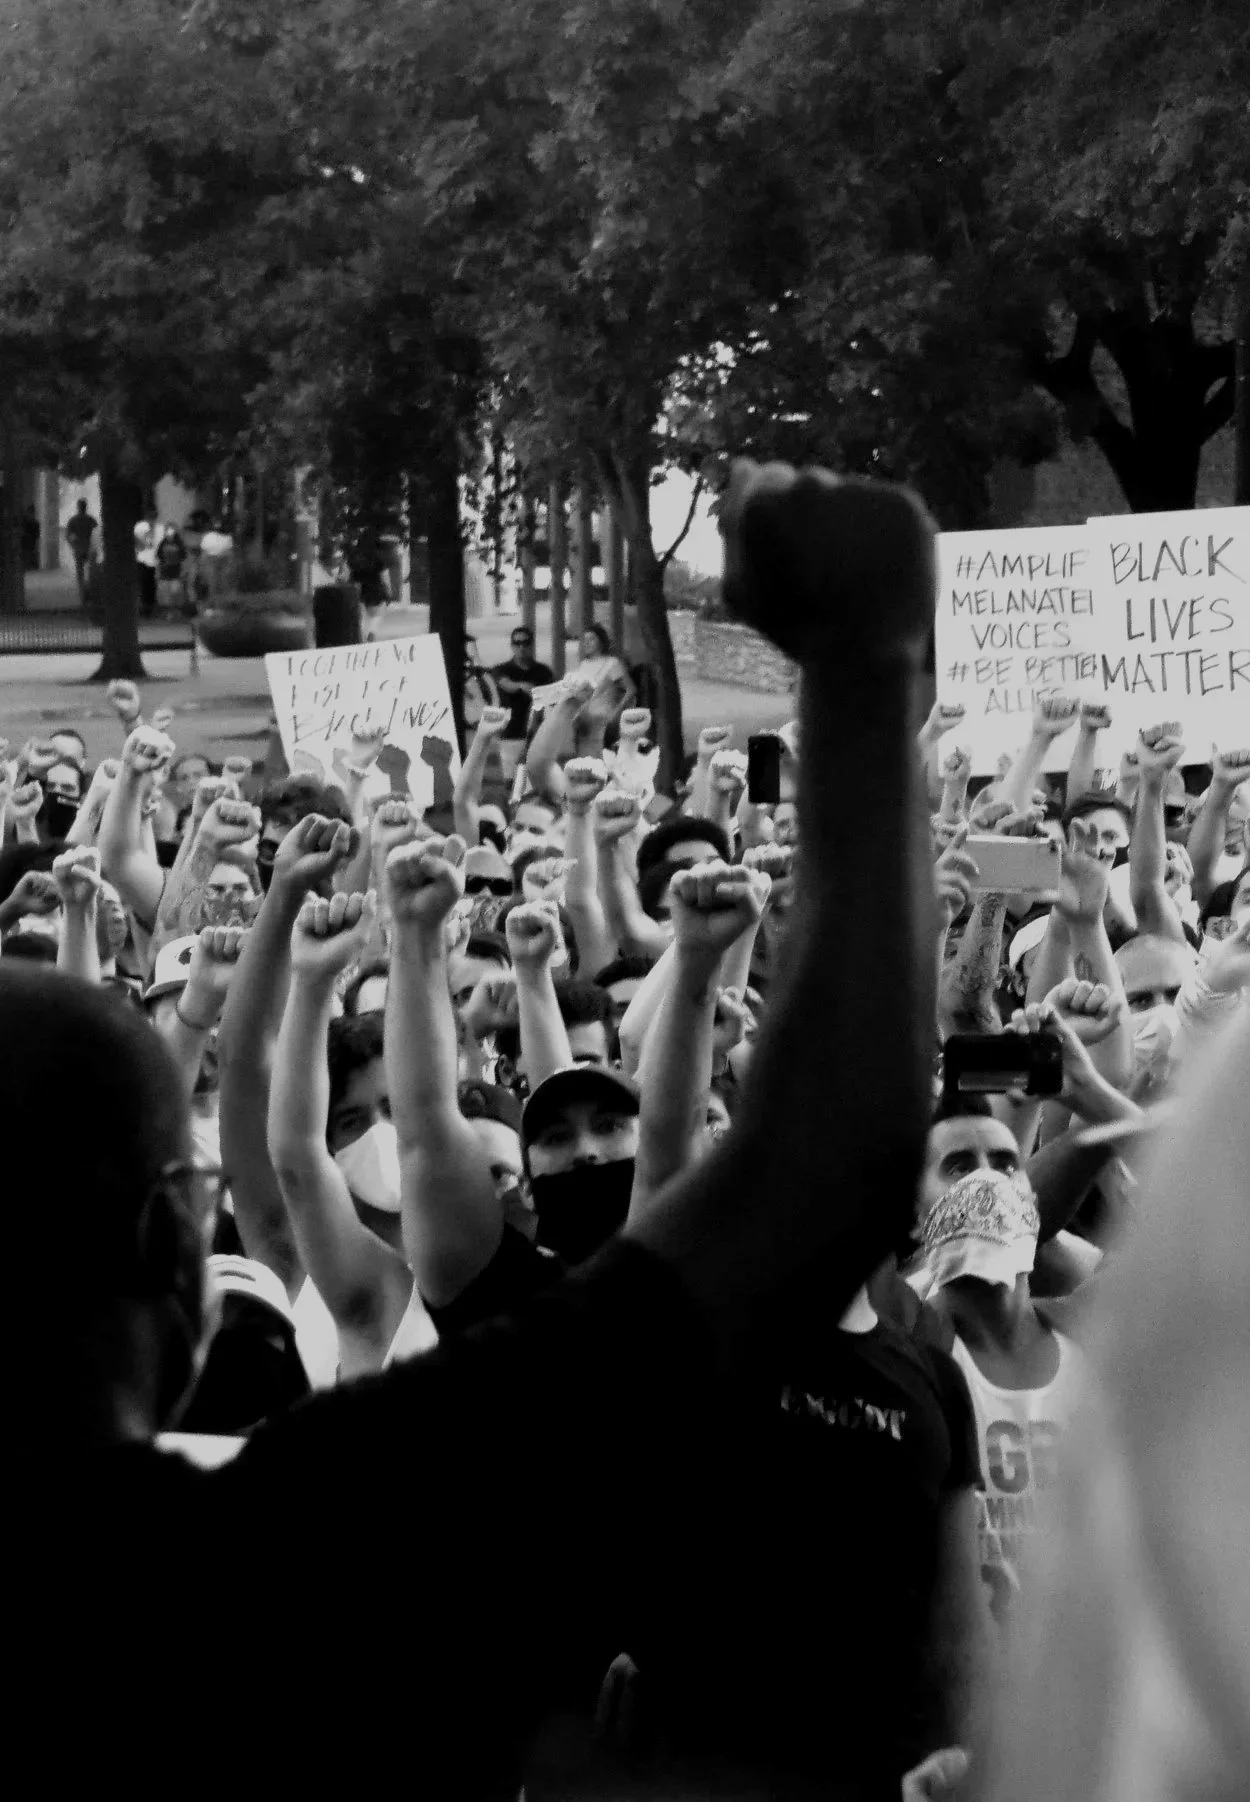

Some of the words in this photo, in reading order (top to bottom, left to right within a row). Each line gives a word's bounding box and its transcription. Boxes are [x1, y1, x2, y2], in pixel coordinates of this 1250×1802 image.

[955, 549, 1090, 582] #AMPLIF
[1110, 534, 1247, 585] BLACK
[951, 587, 1094, 617] MELANATE
[1126, 596, 1235, 643] LIVES
[971, 621, 1072, 650] VOICES
[946, 656, 1011, 685] #BE
[984, 687, 1064, 715] ALLI
